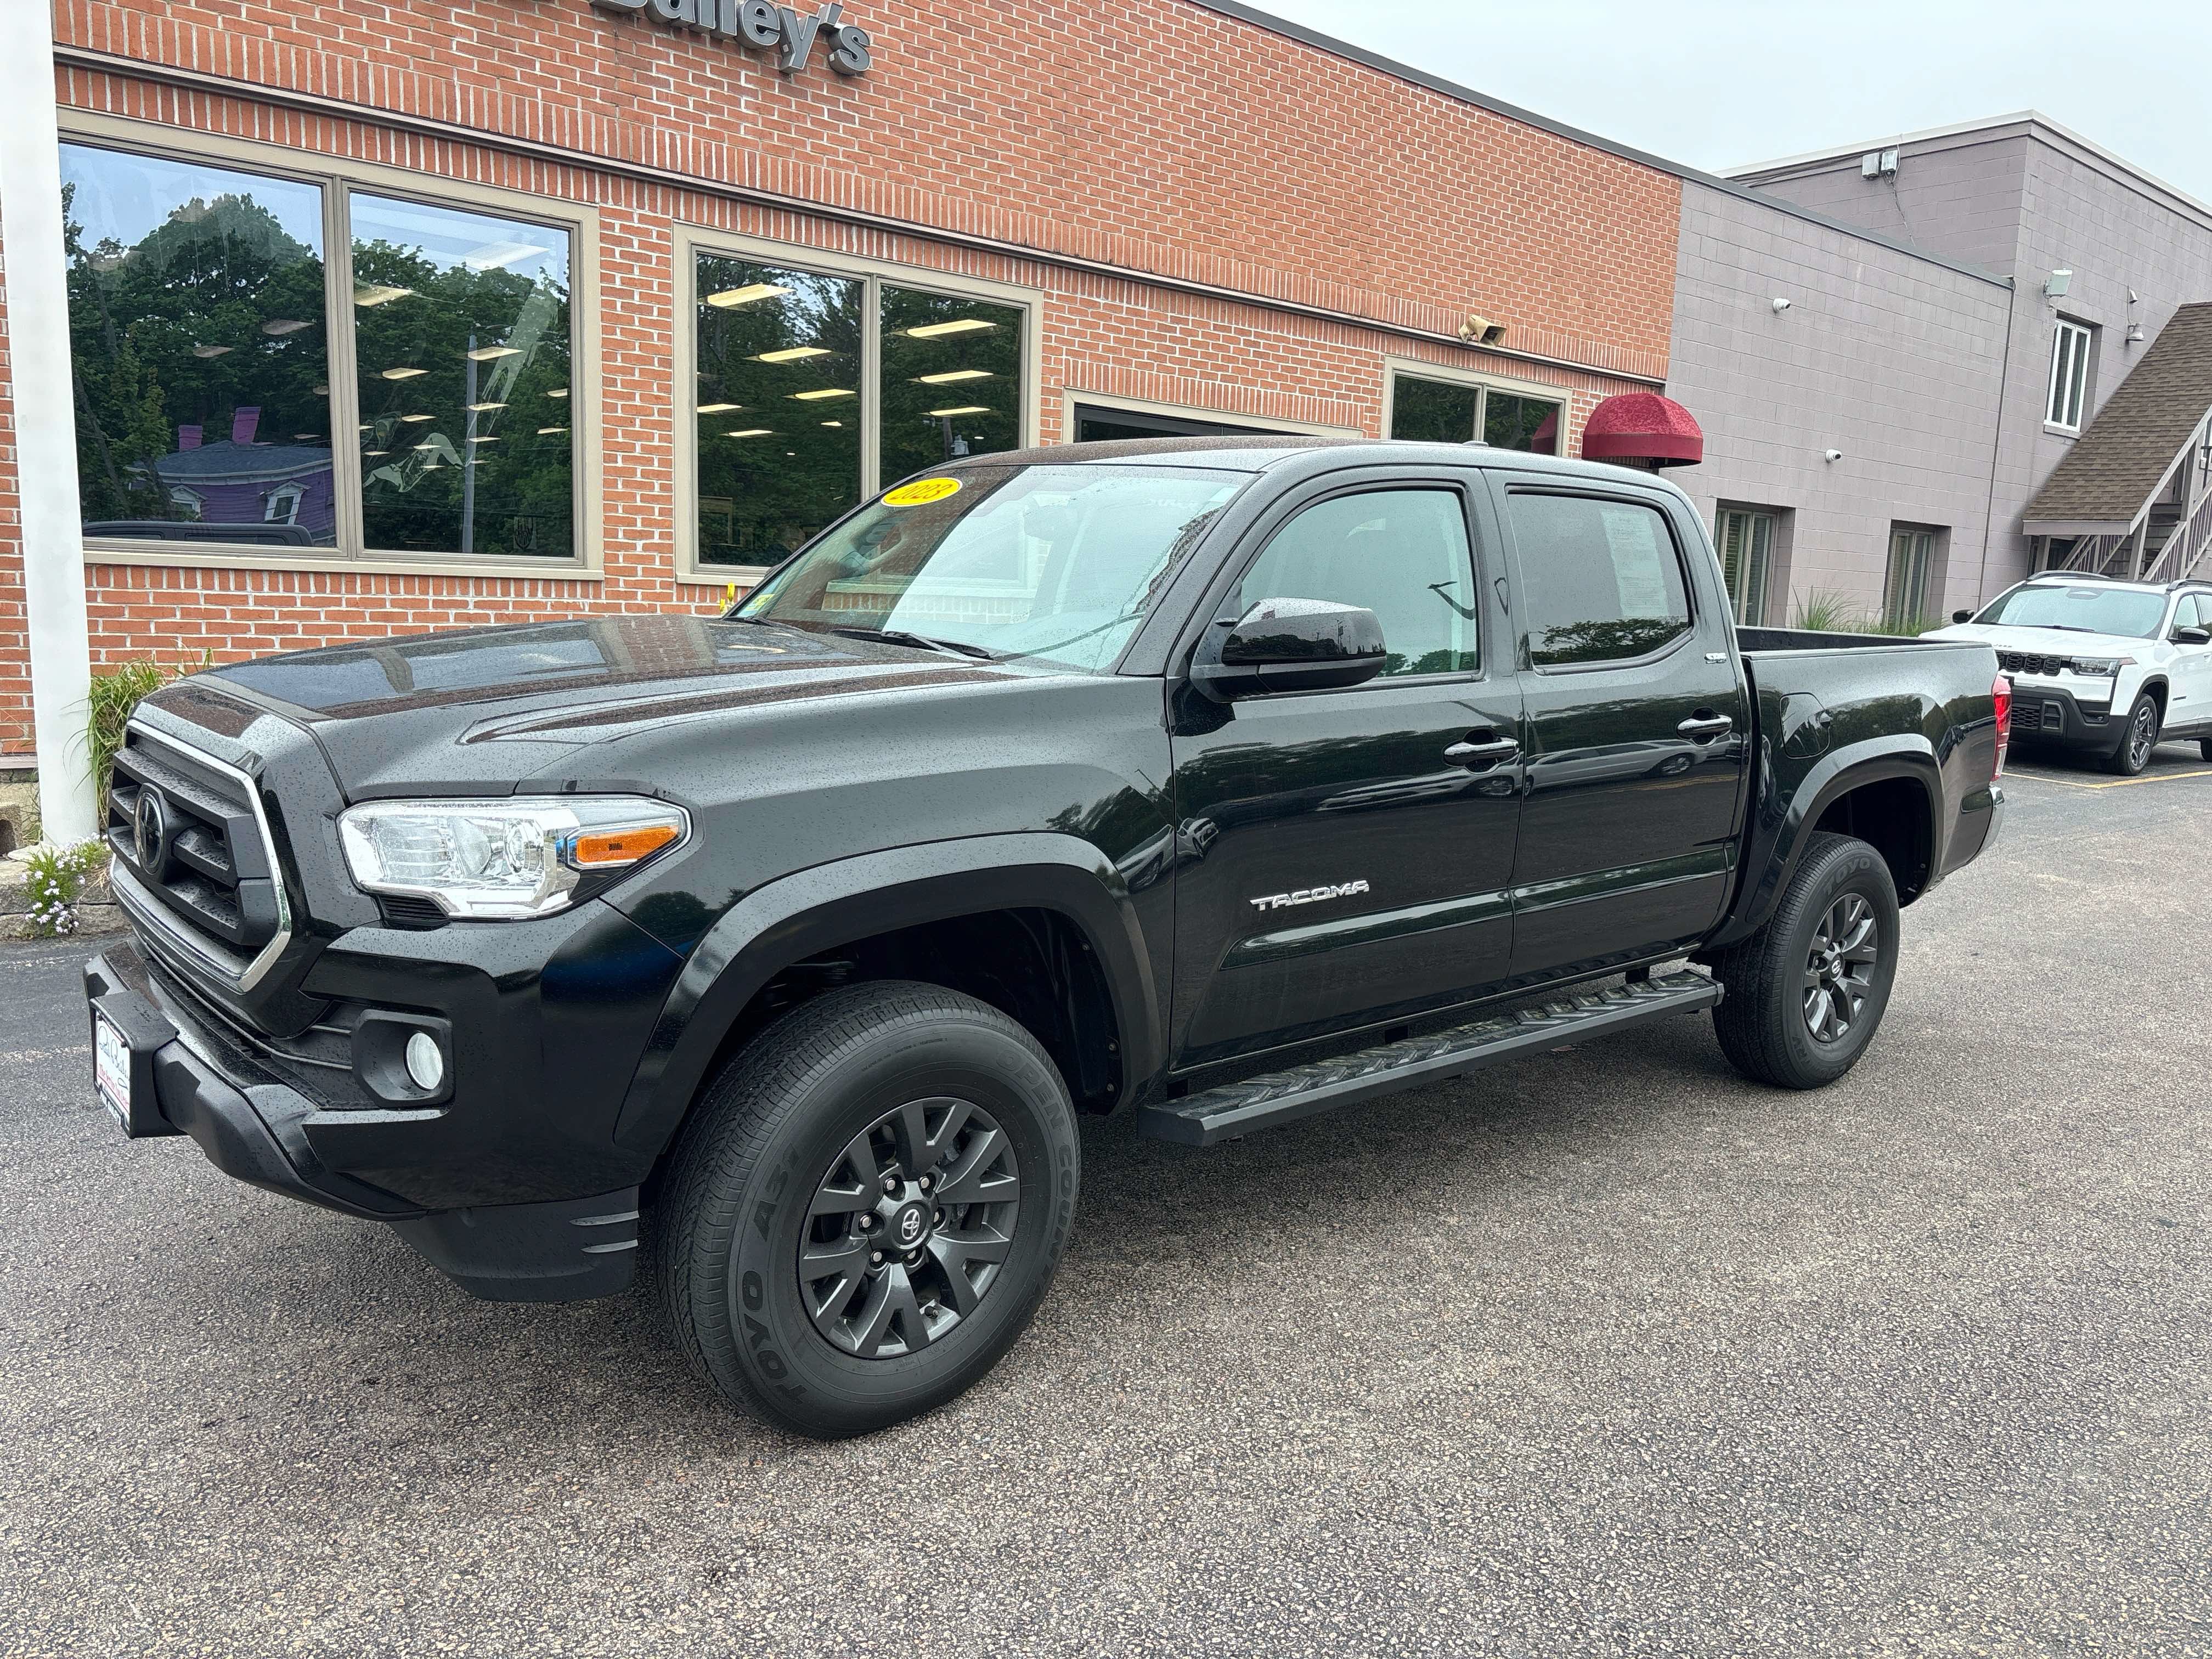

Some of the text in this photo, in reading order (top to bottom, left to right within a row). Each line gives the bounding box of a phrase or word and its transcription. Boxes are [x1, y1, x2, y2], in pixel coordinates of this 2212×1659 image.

[590, 0, 871, 74] ailey's
[889, 484, 953, 500] 2023
[1249, 879, 1370, 911] TACOMA
[1823, 857, 1870, 895] TOYO
[996, 1049, 1065, 1130] OPEN
[742, 1269, 808, 1405] TOYO
